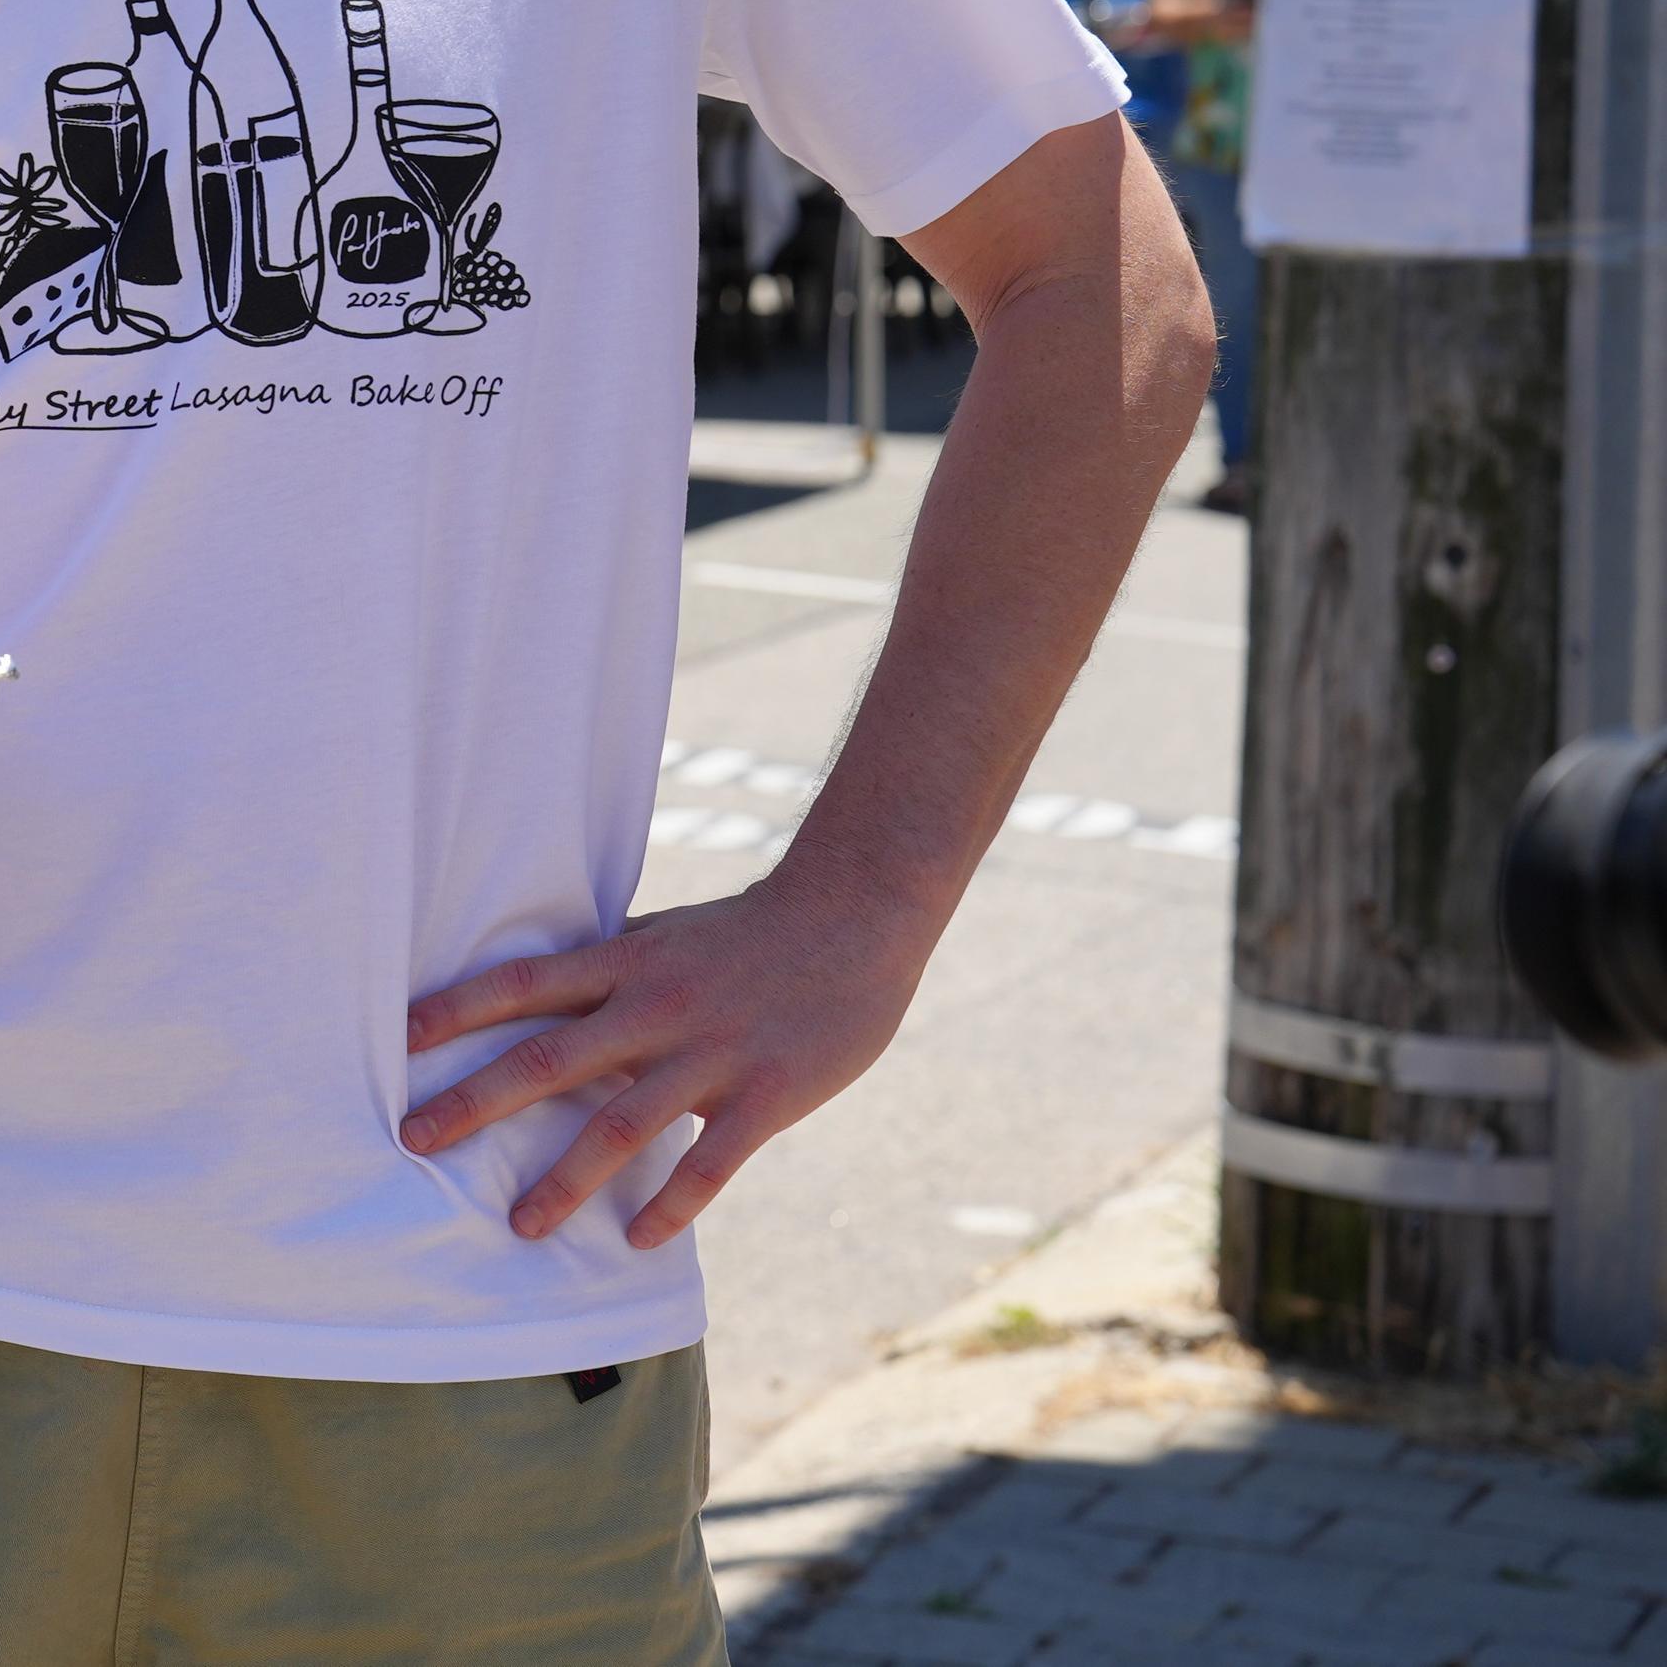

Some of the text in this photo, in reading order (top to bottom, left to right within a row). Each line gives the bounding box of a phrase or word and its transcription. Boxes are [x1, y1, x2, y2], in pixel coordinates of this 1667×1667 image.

[347, 291, 411, 310] 2025
[45, 388, 164, 423] Street
[170, 381, 332, 415] Lasagna
[350, 374, 436, 407] Bake
[440, 374, 503, 418] Off
